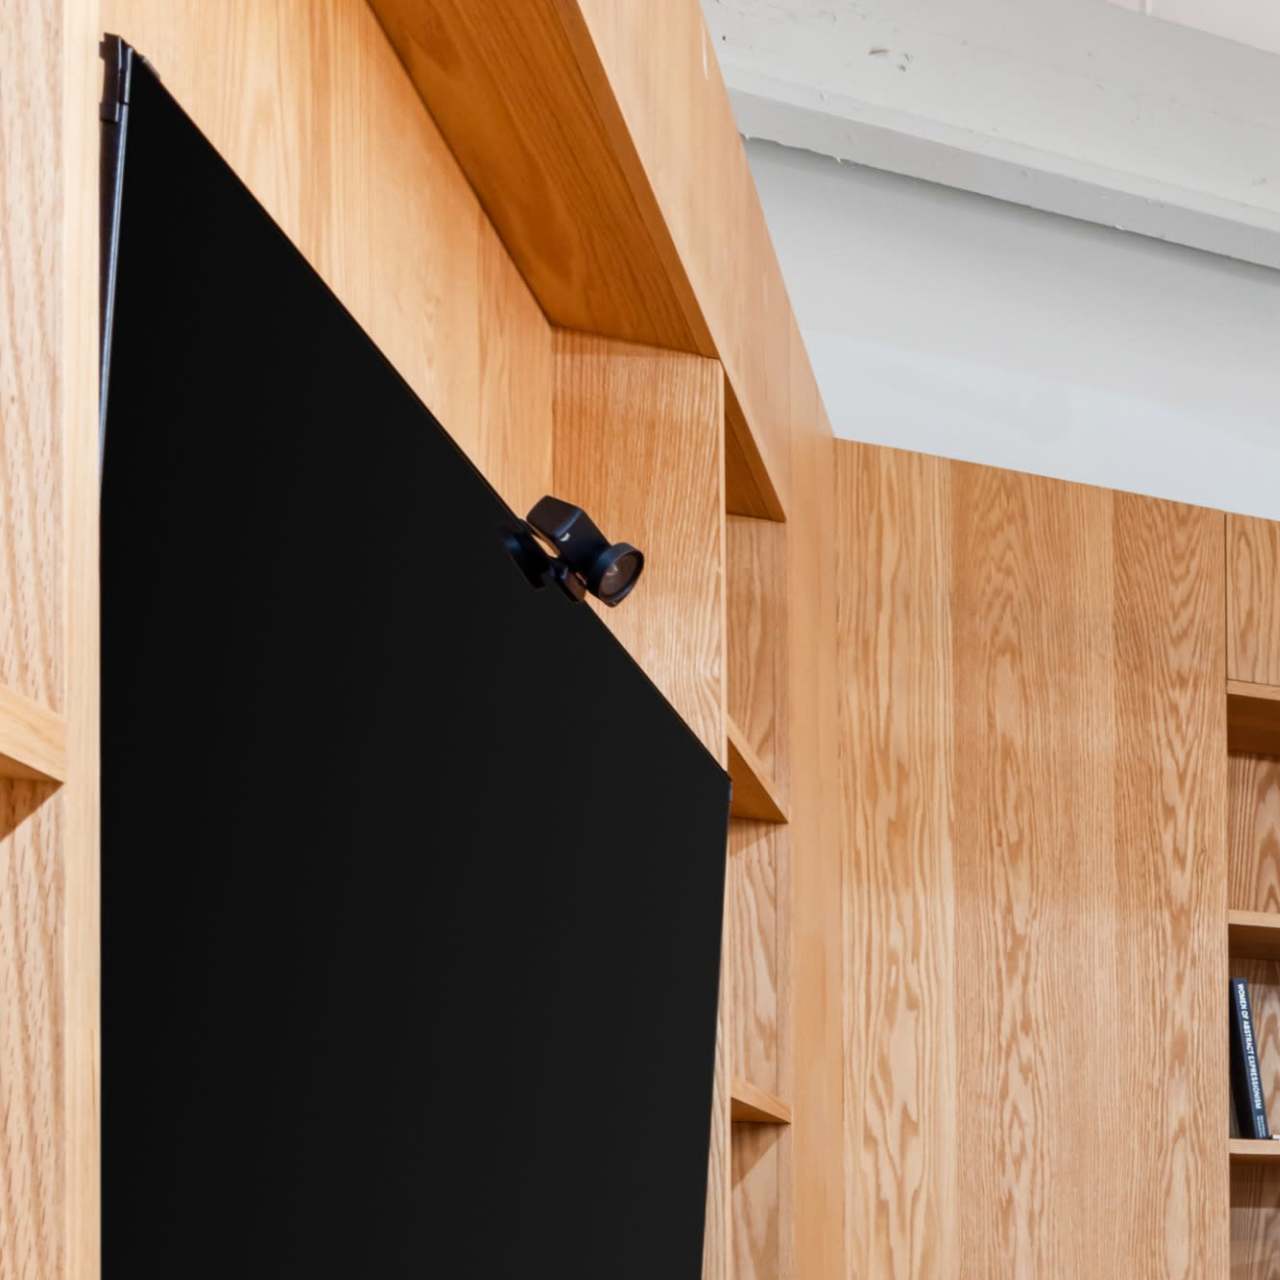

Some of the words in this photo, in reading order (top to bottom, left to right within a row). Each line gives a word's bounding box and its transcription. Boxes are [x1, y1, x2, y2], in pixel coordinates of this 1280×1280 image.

[1237, 983, 1248, 1011] WOMEN
[1243, 1020, 1255, 1056] ABSTRACT
[1248, 1056, 1263, 1110] EXPRESSIONISM
